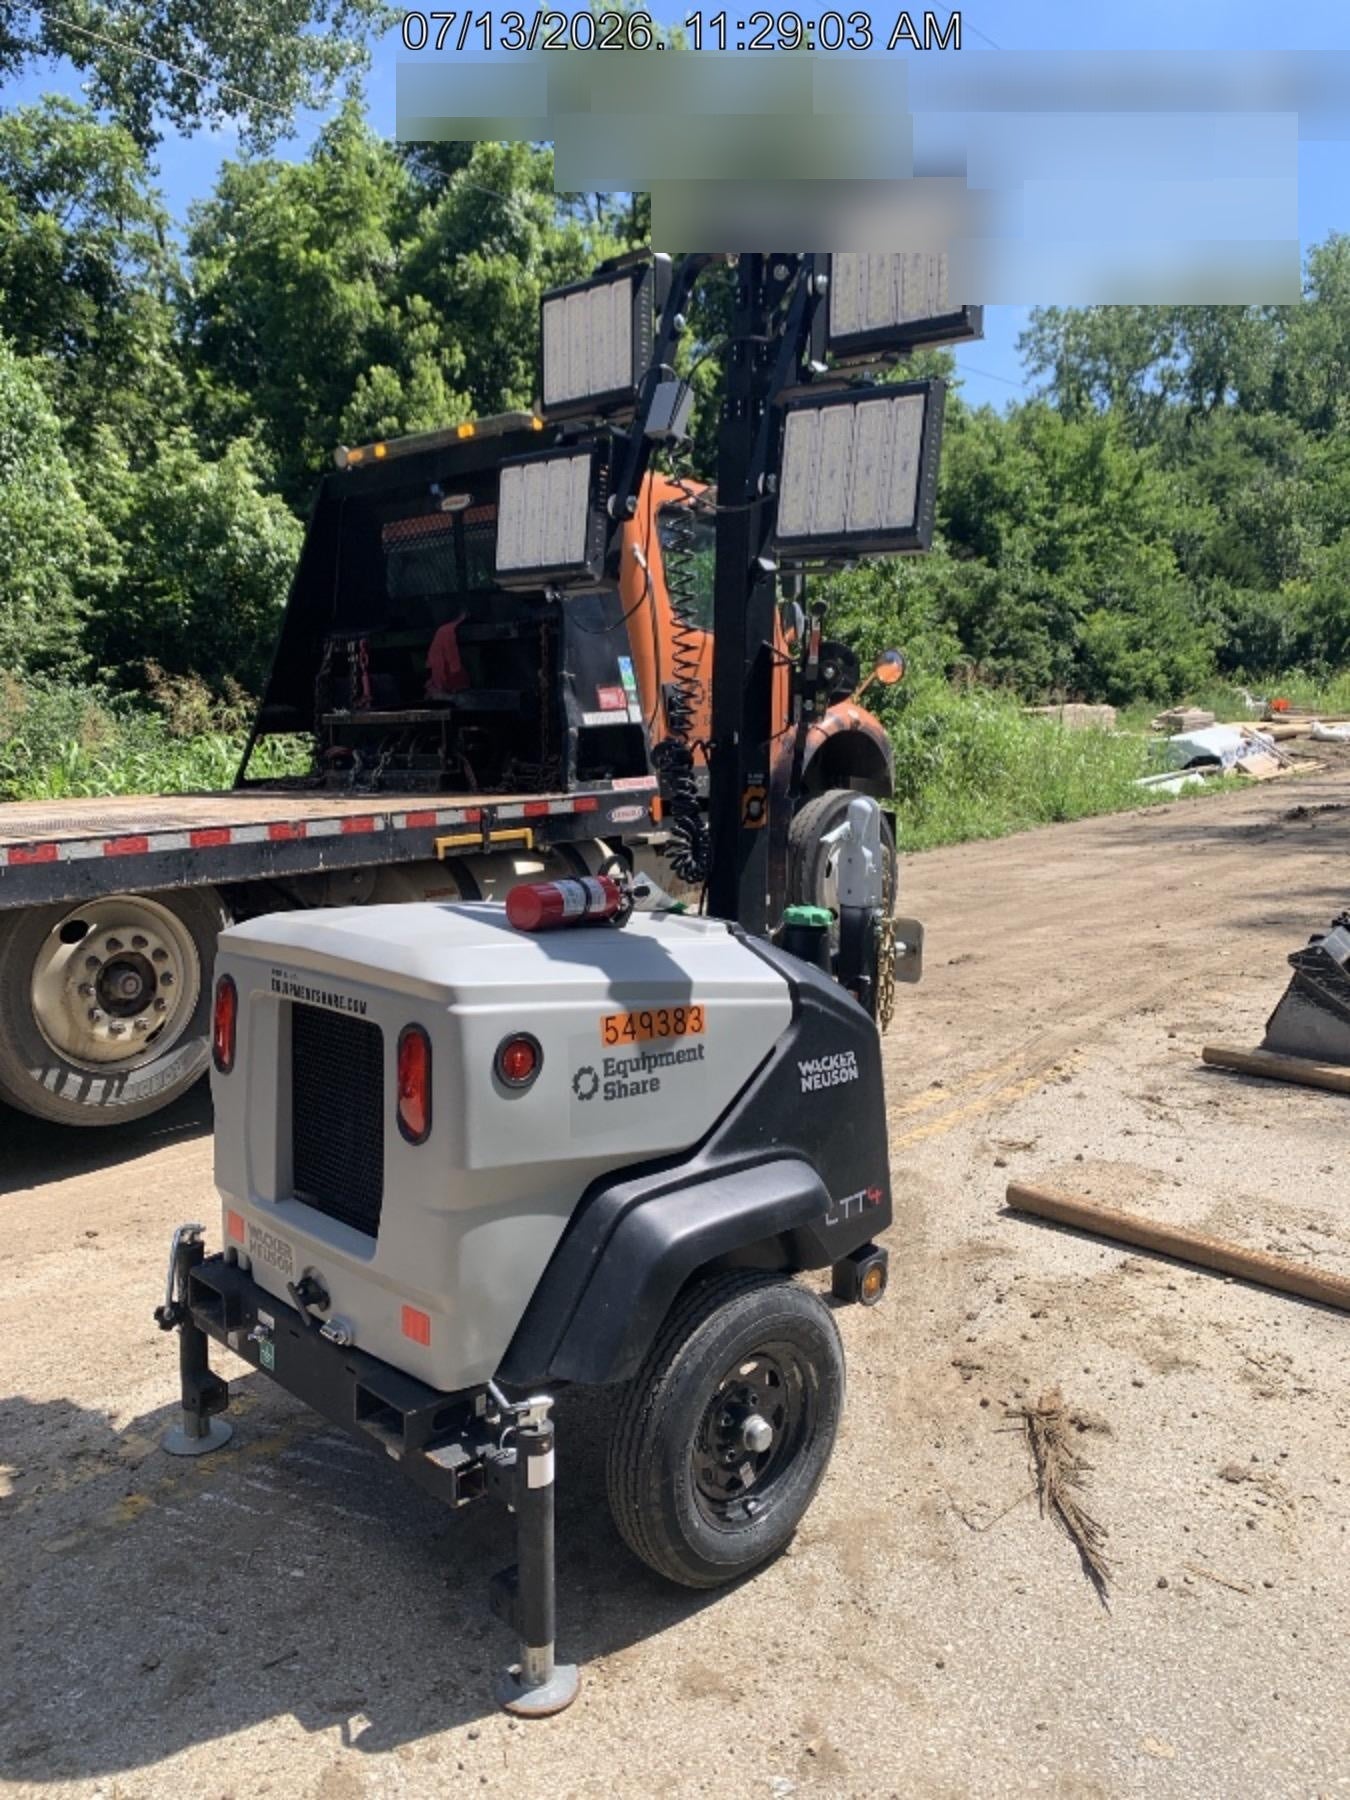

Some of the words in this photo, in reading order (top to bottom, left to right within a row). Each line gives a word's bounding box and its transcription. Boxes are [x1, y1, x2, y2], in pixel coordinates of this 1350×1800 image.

[604, 1006, 704, 1045] 549383
[602, 1043, 705, 1078] Equipment
[797, 1050, 857, 1076] WACKER
[602, 1077, 661, 1101] Share
[800, 1066, 860, 1093] NEUSON
